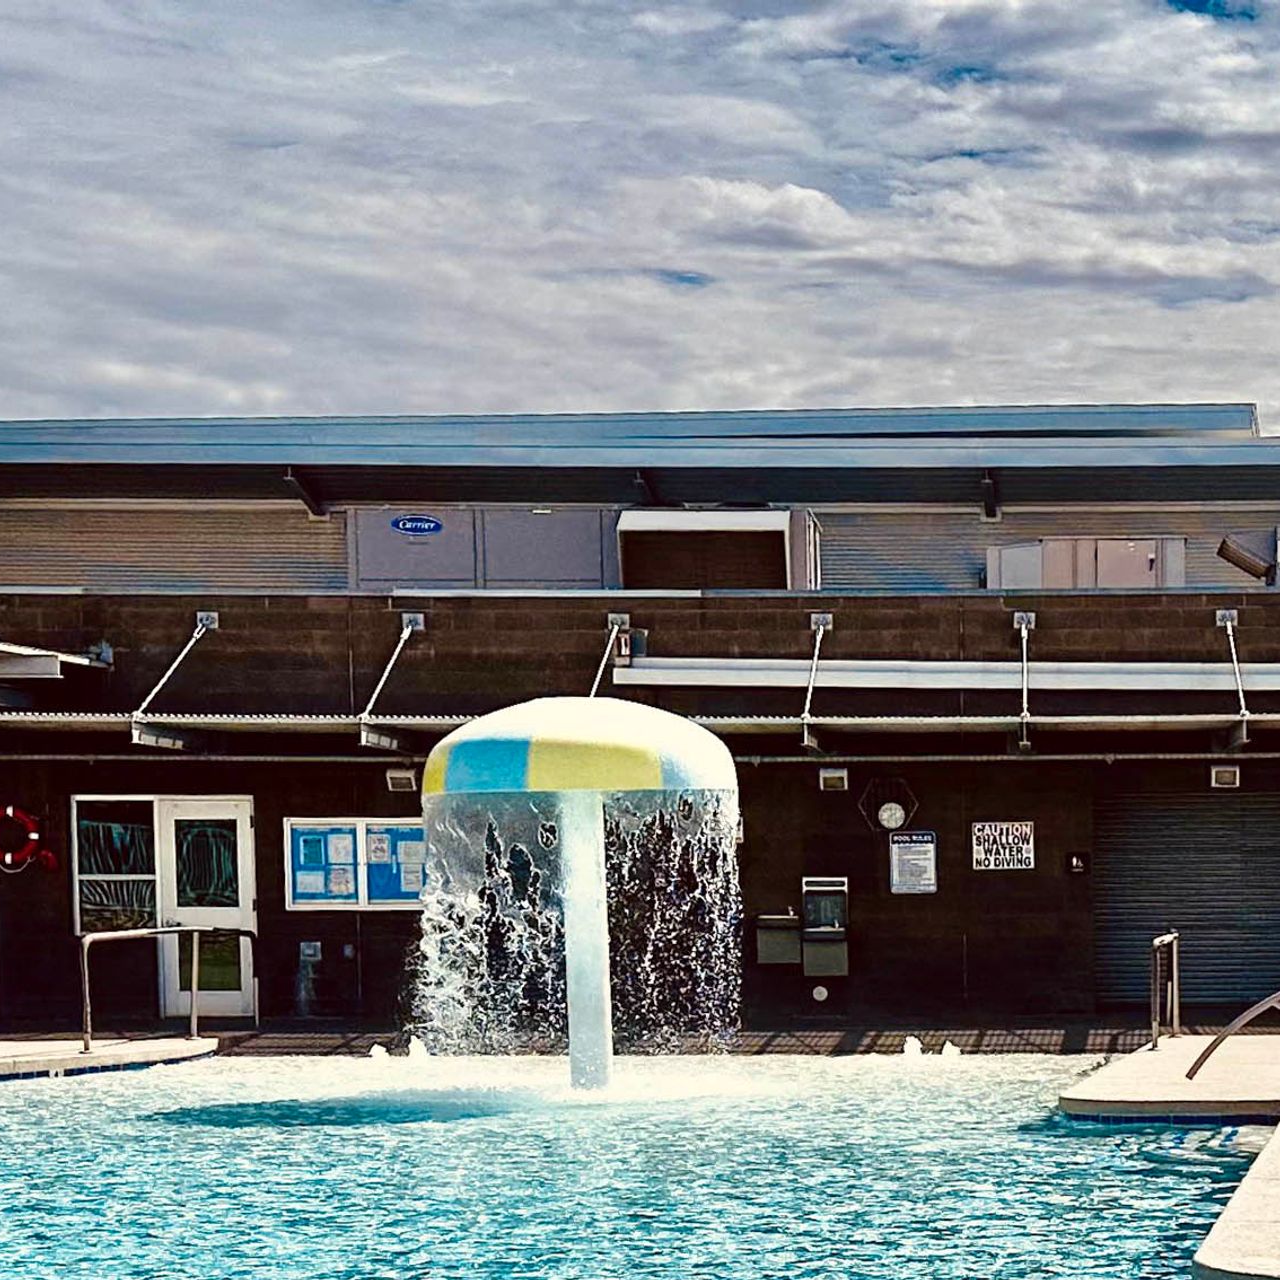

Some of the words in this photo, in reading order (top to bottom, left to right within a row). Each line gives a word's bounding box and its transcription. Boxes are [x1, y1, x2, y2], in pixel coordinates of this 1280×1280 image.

[399, 520, 436, 529] Carrier
[974, 824, 1032, 836] CAUTION
[975, 834, 1031, 846] SHALLOW
[983, 846, 1023, 857] WATER
[976, 857, 991, 867] NO
[994, 856, 1031, 867] DIVING
